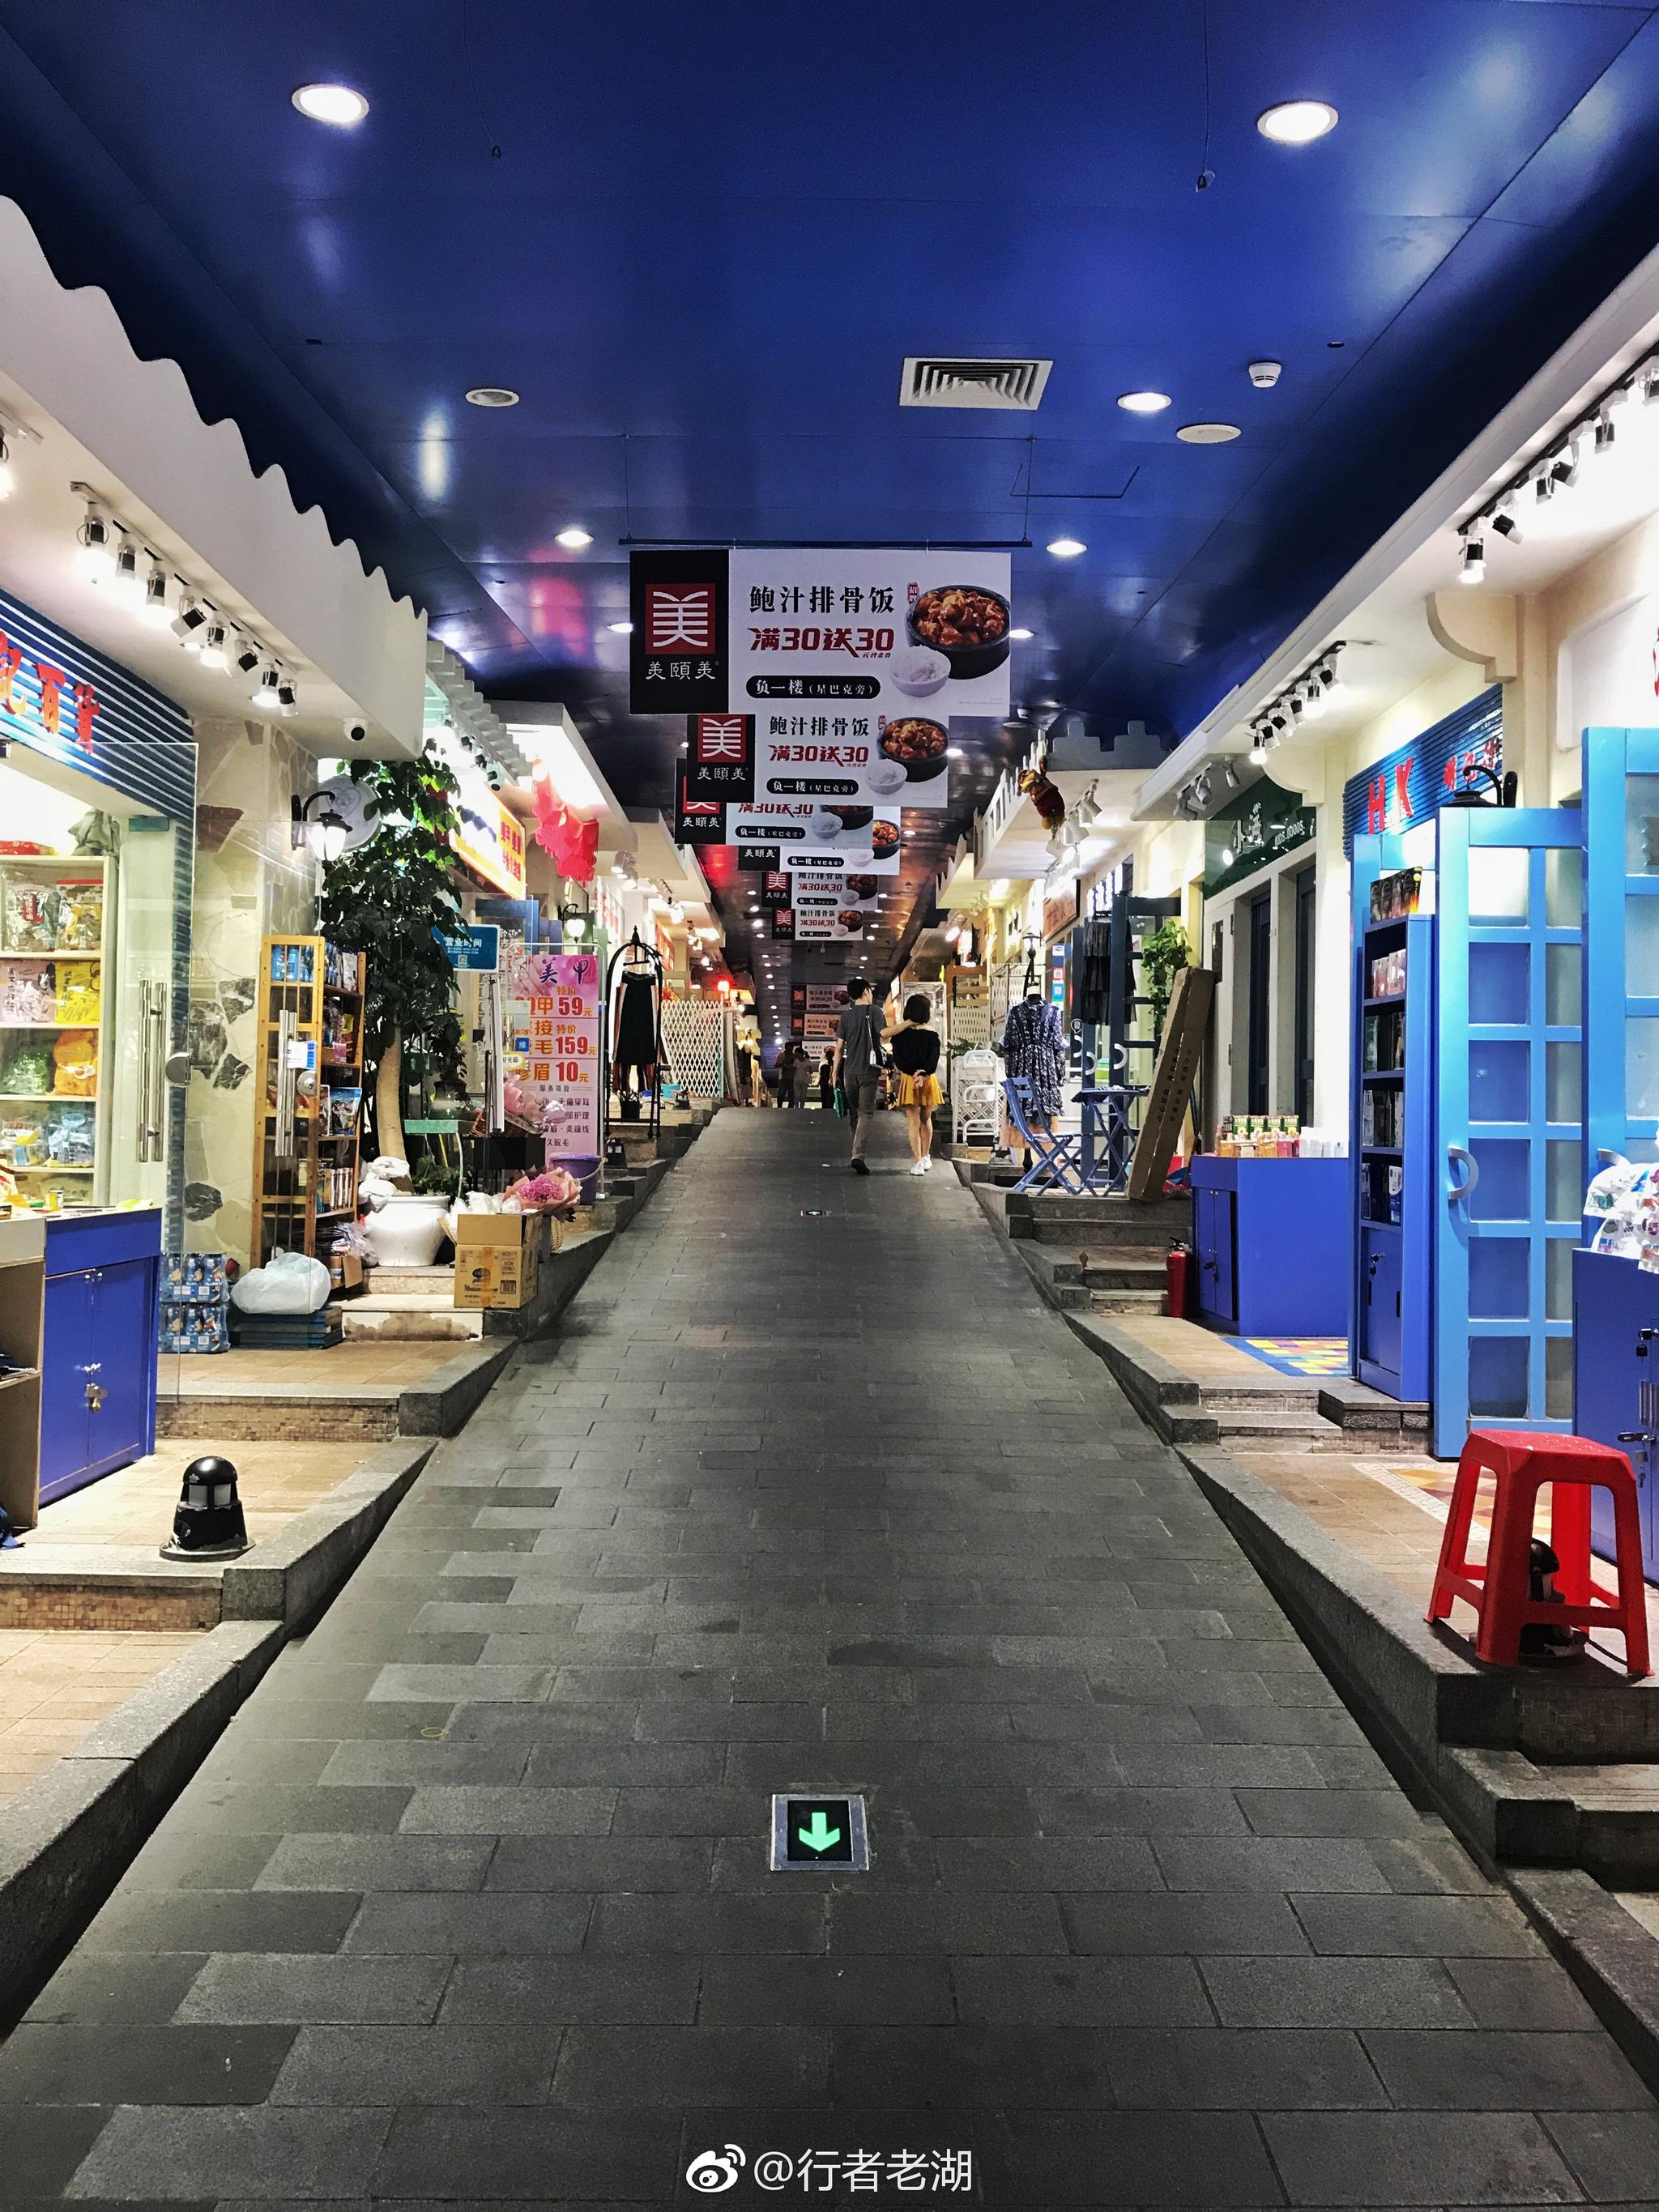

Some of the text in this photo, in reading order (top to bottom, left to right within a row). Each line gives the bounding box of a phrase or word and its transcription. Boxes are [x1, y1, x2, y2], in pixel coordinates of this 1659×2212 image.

[749, 586, 895, 614] 鲍汁排骨饭
[747, 627, 895, 658] 满30送30
[770, 716, 870, 737] 鲍汁排骨饭
[767, 744, 870, 767] 满30送30
[539, 957, 590, 986] 美甲
[557, 986, 577, 995] 特价
[557, 1024, 577, 1034] 特价
[546, 1138, 569, 1147] 久脱毛
